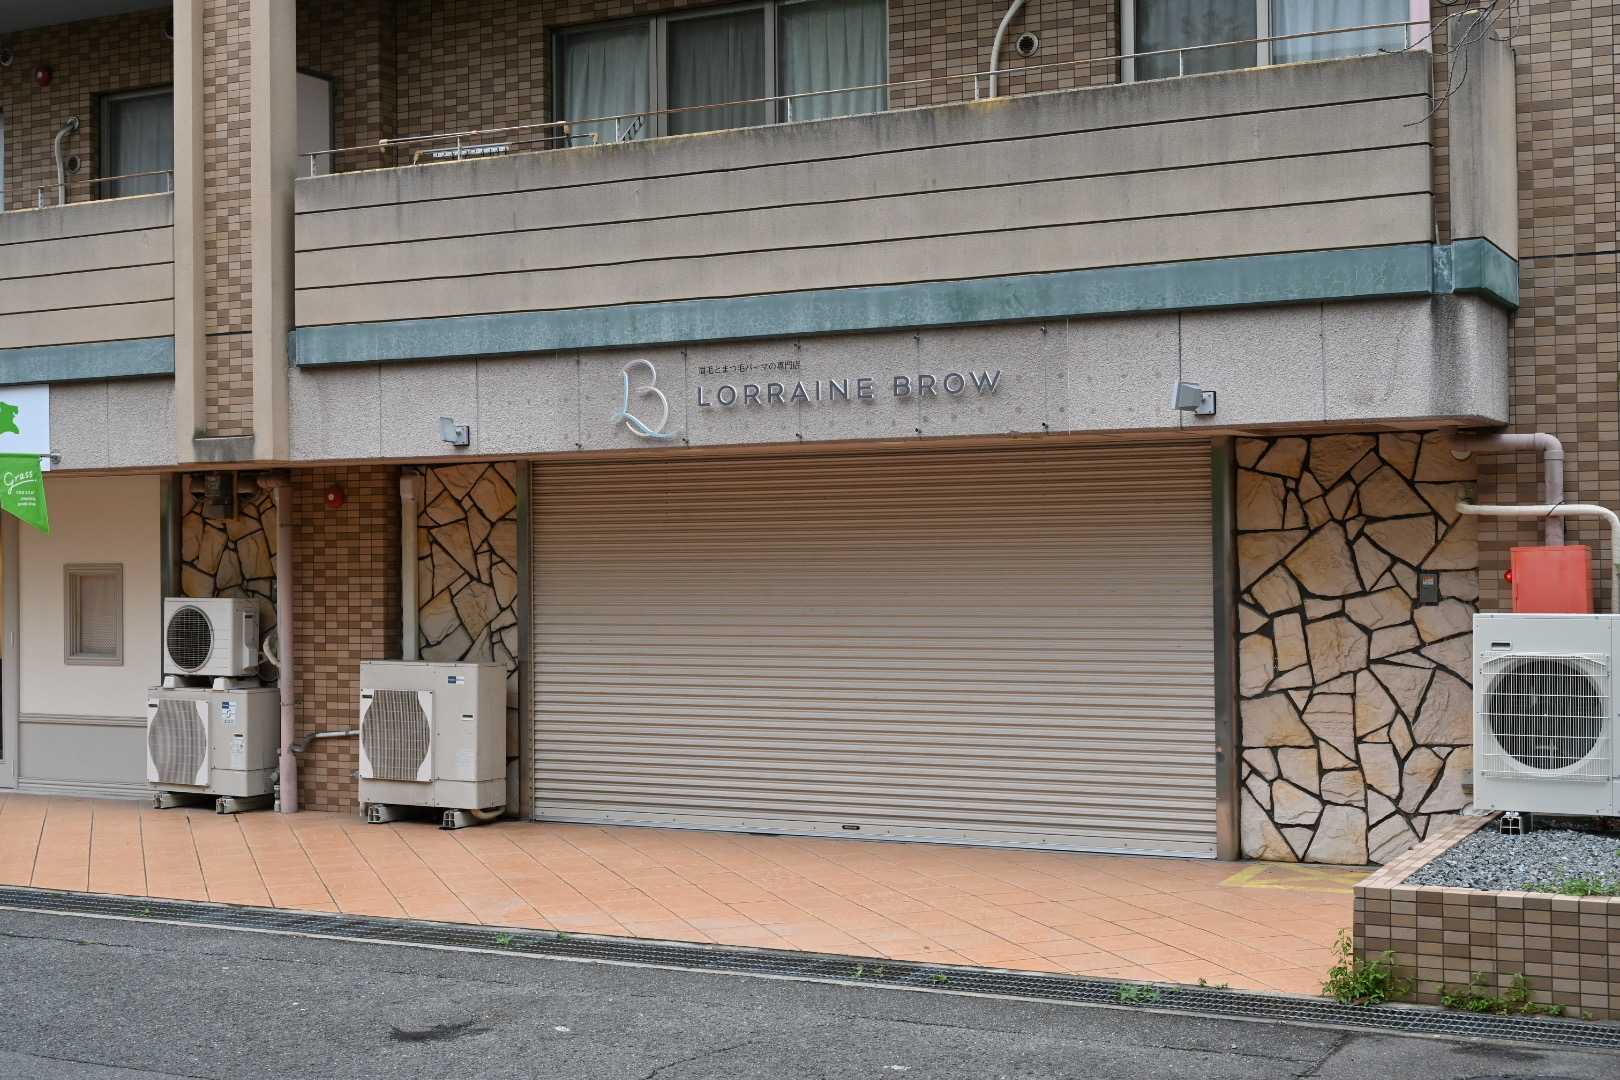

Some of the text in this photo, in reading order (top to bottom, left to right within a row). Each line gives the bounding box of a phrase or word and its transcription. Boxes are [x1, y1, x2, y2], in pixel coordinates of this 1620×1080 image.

[698, 360, 801, 375] 眉毛とまつ毛パーマの専門店
[697, 370, 1001, 407] LORRAINE BROW
